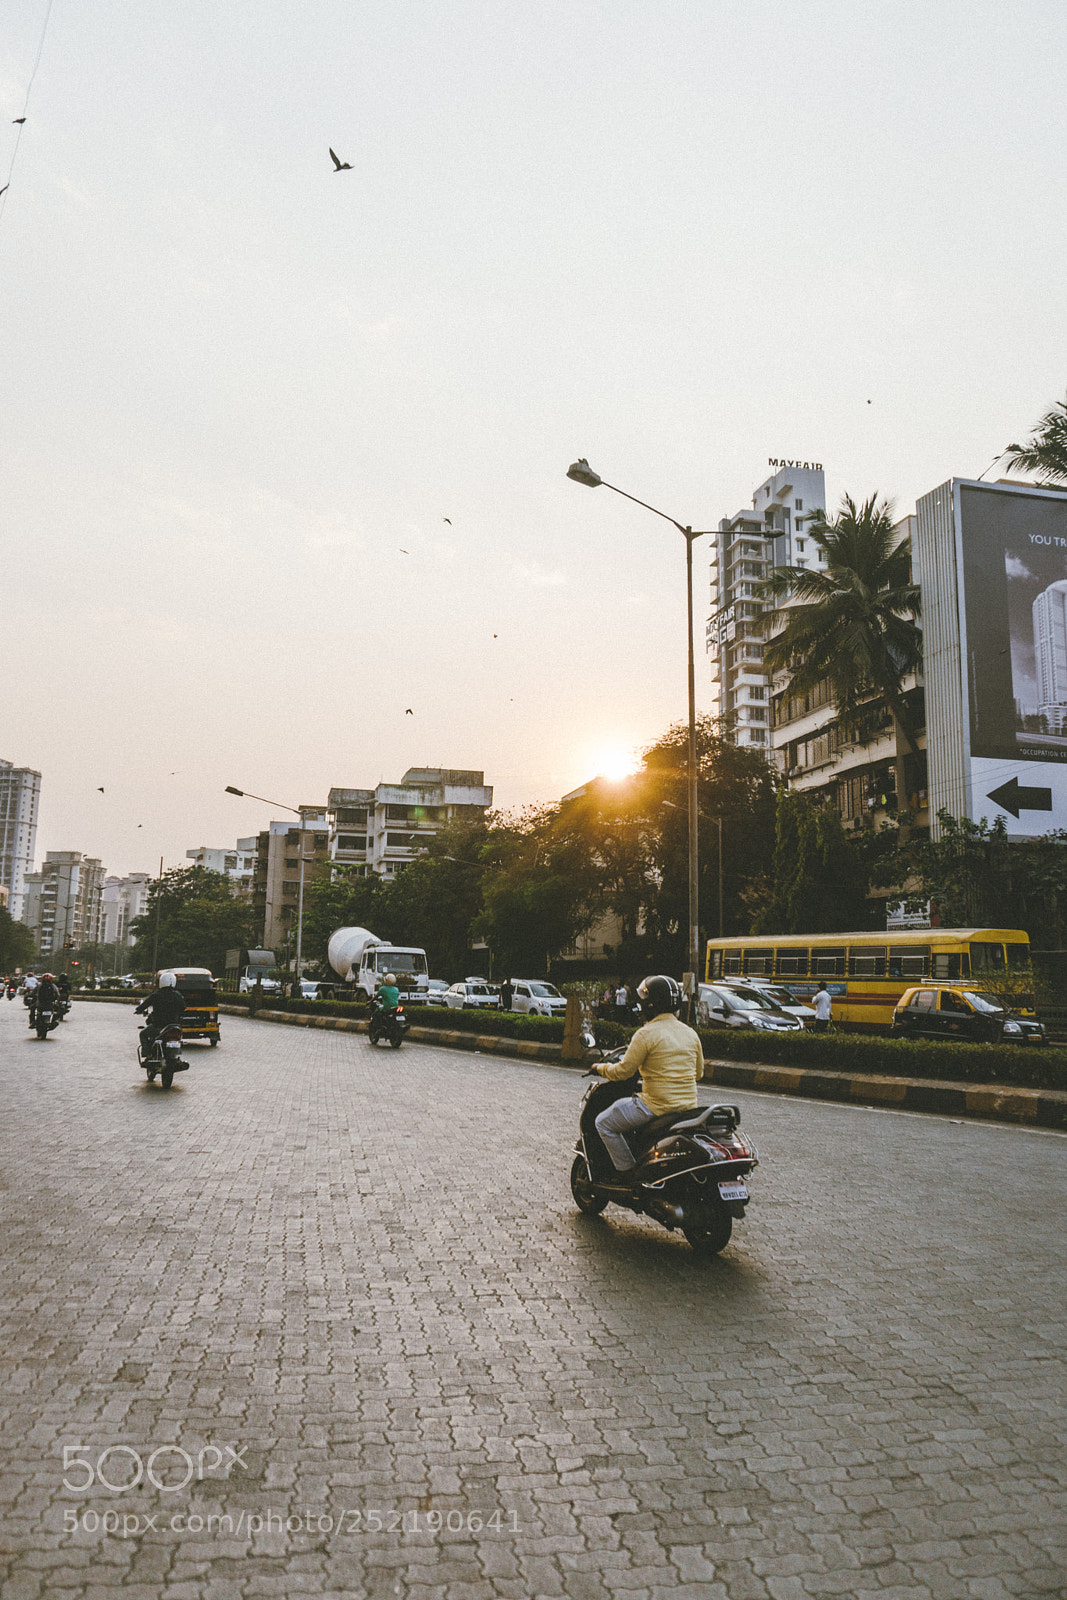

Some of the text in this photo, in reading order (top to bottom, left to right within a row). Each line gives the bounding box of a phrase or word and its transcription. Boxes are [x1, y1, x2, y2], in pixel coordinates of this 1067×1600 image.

[768, 458, 823, 471] MAYFAIR
[1028, 533, 1052, 545] YOU
[705, 605, 735, 636] MAYFAIR
